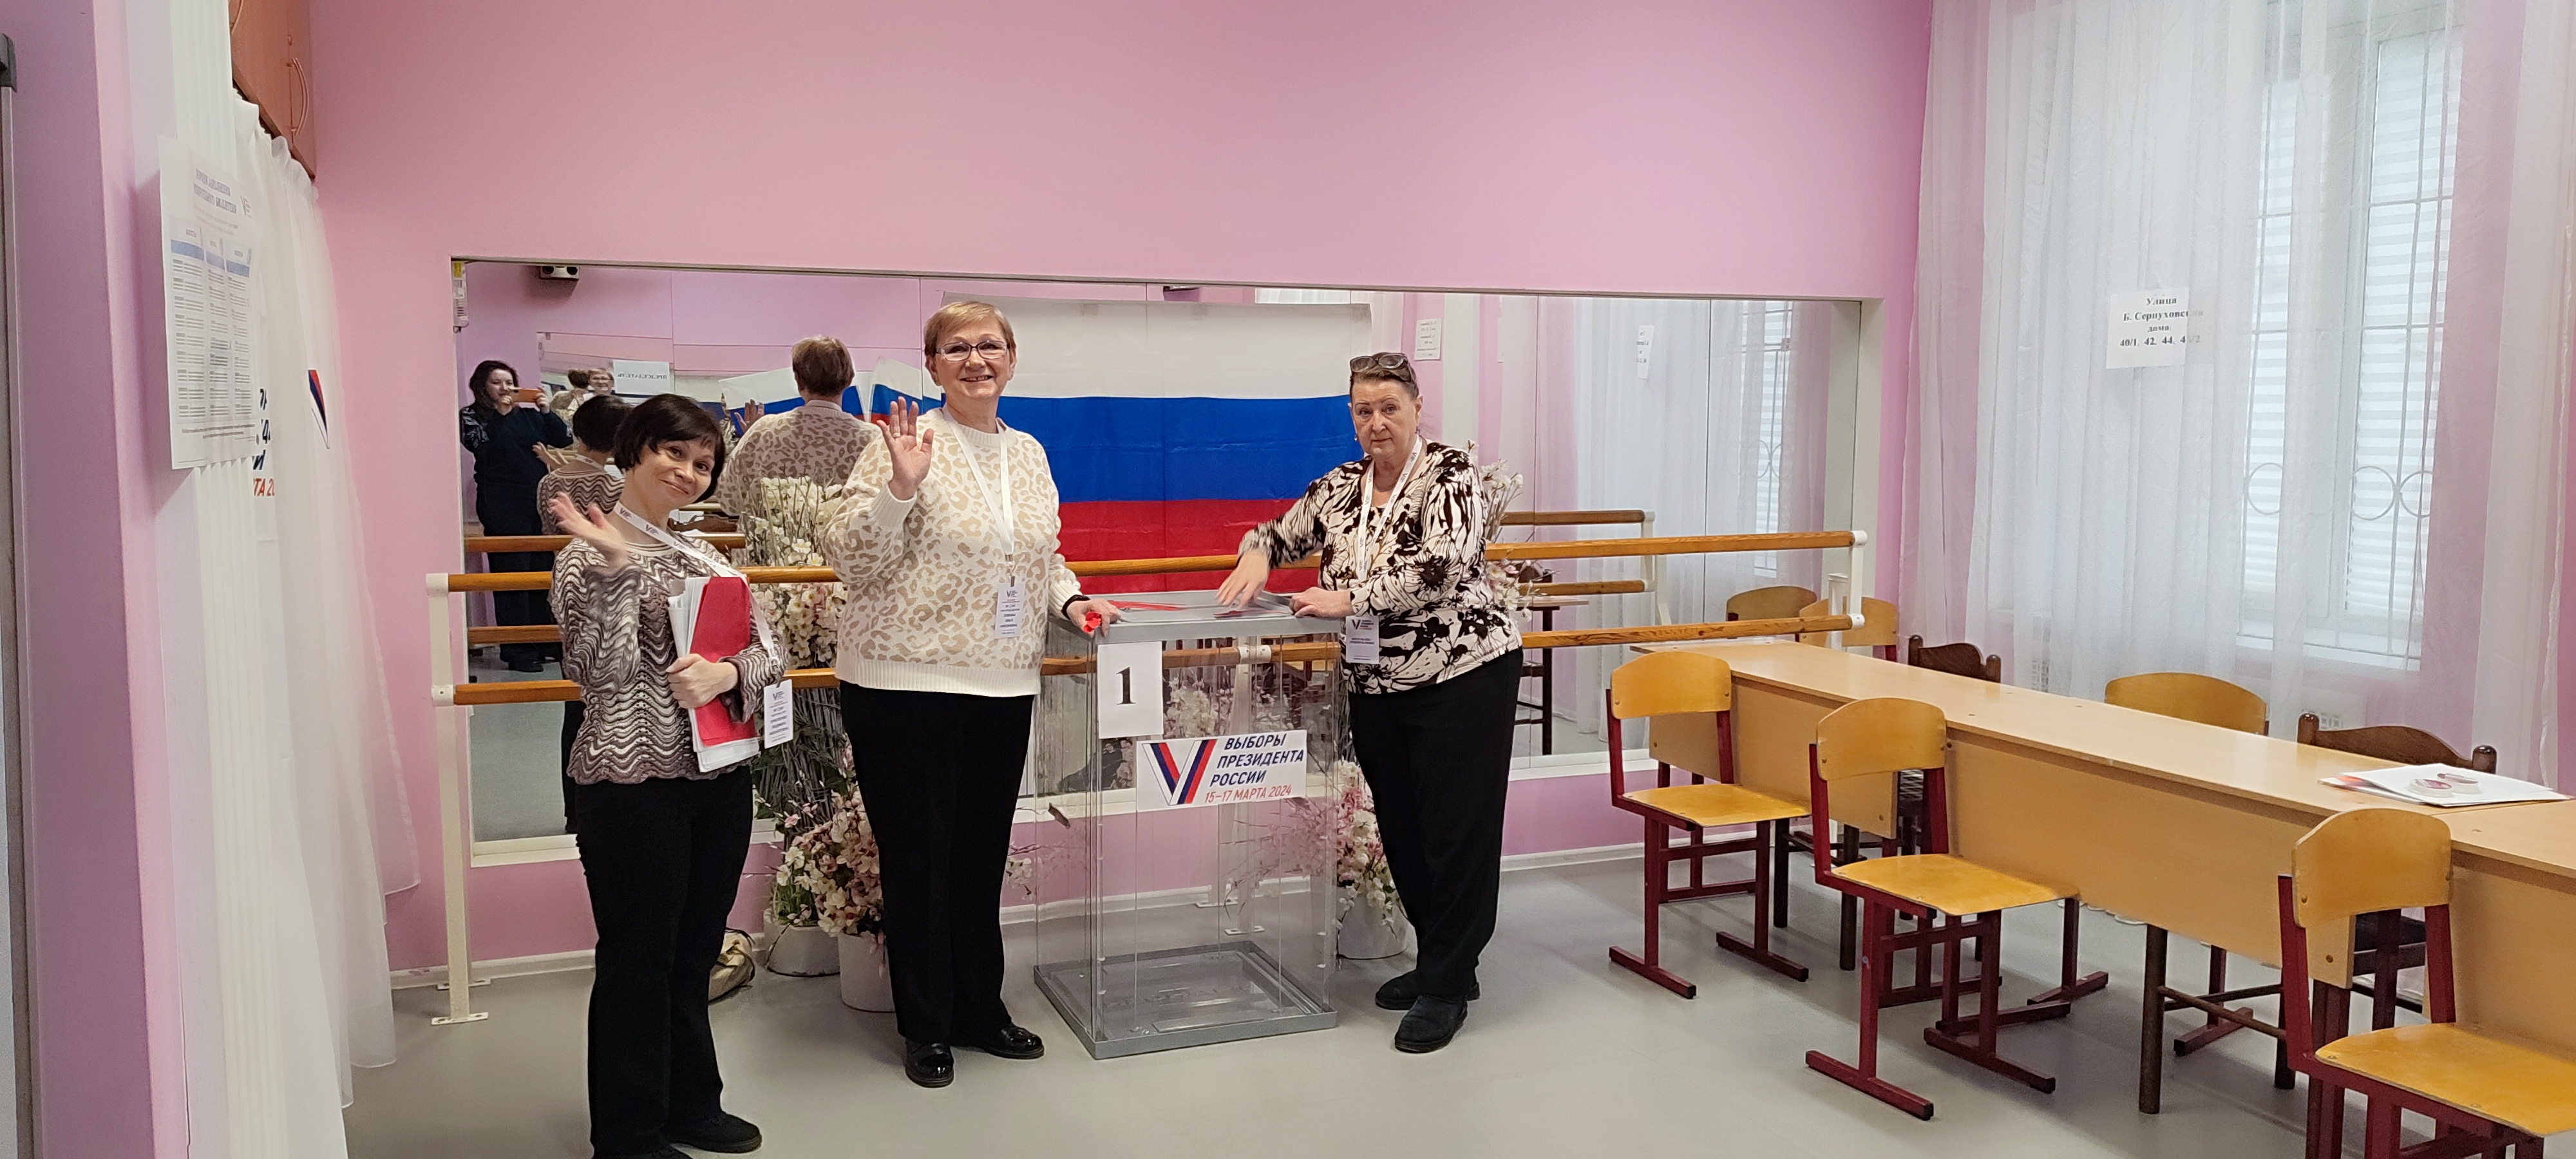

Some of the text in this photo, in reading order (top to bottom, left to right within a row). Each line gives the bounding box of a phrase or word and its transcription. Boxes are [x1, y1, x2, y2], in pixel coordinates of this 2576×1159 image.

[2146, 297, 2177, 306] Улица
[2123, 313, 2132, 321] Б.
[1116, 666, 1136, 705] 1
[1224, 733, 1287, 750] ВЫБОРЫ
[1217, 749, 1304, 769] ПРЕЗИДЕНТА
[1209, 770, 1267, 787] РОССИИ
[1233, 787, 1267, 801] МАРТА
[1268, 784, 1292, 798] 2024
